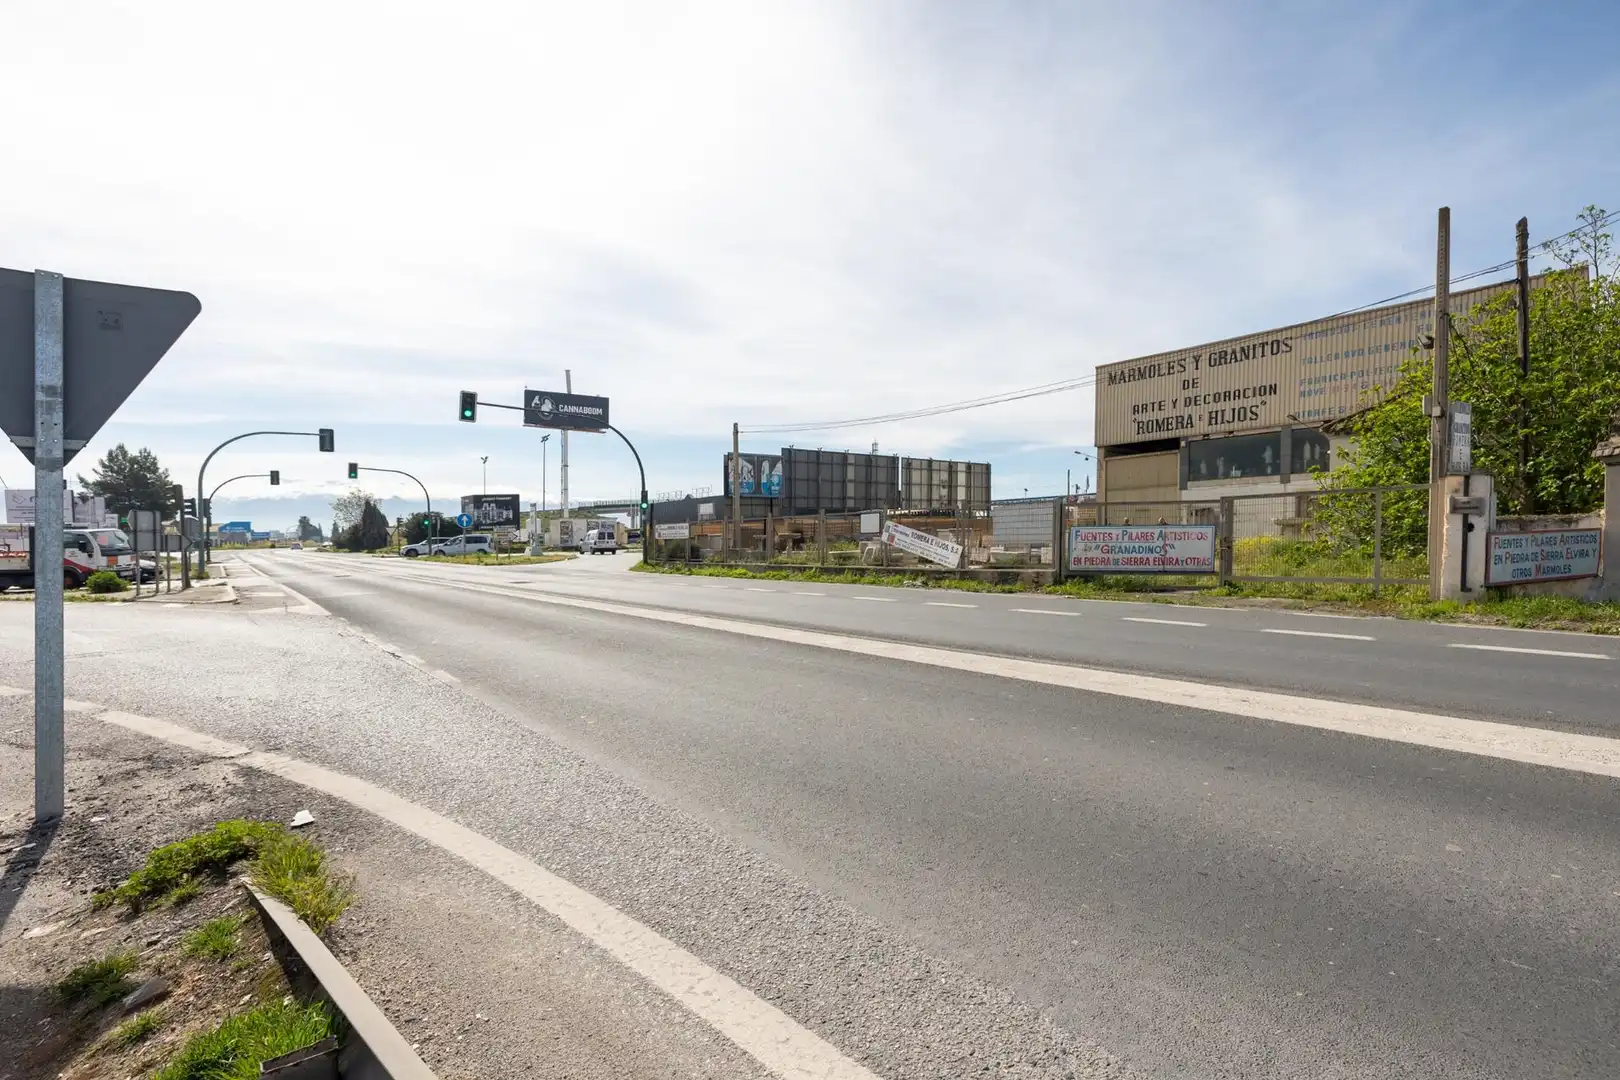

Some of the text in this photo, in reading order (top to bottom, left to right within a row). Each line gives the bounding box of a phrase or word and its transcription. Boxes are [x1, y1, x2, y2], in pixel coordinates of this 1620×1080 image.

[1107, 337, 1292, 386] MARMOLES Y GRANITOS
[1182, 377, 1200, 390] DE
[1132, 383, 1277, 415] ARTE Y DECORACION
[558, 404, 603, 416] CANNABOOM
[1075, 529, 1113, 542] FUENTES
[1121, 529, 1156, 542] PILARES
[1156, 529, 1208, 542] ARTISTICOS
[1494, 533, 1598, 549] FUENTES Y PILARES ARTISTICOS
[1073, 557, 1082, 566] EN
[1084, 557, 1112, 566] PIEDRA
[1112, 559, 1120, 567] DE
[1120, 557, 1151, 566] SIERRA
[1152, 557, 1180, 567] ELVIRA
[1185, 557, 1211, 567] OTRAS
[1494, 547, 1597, 565] EN PIEDRA DE SIERRA ELVIRA Y
[1511, 563, 1573, 579] OTROS MARMOLES
